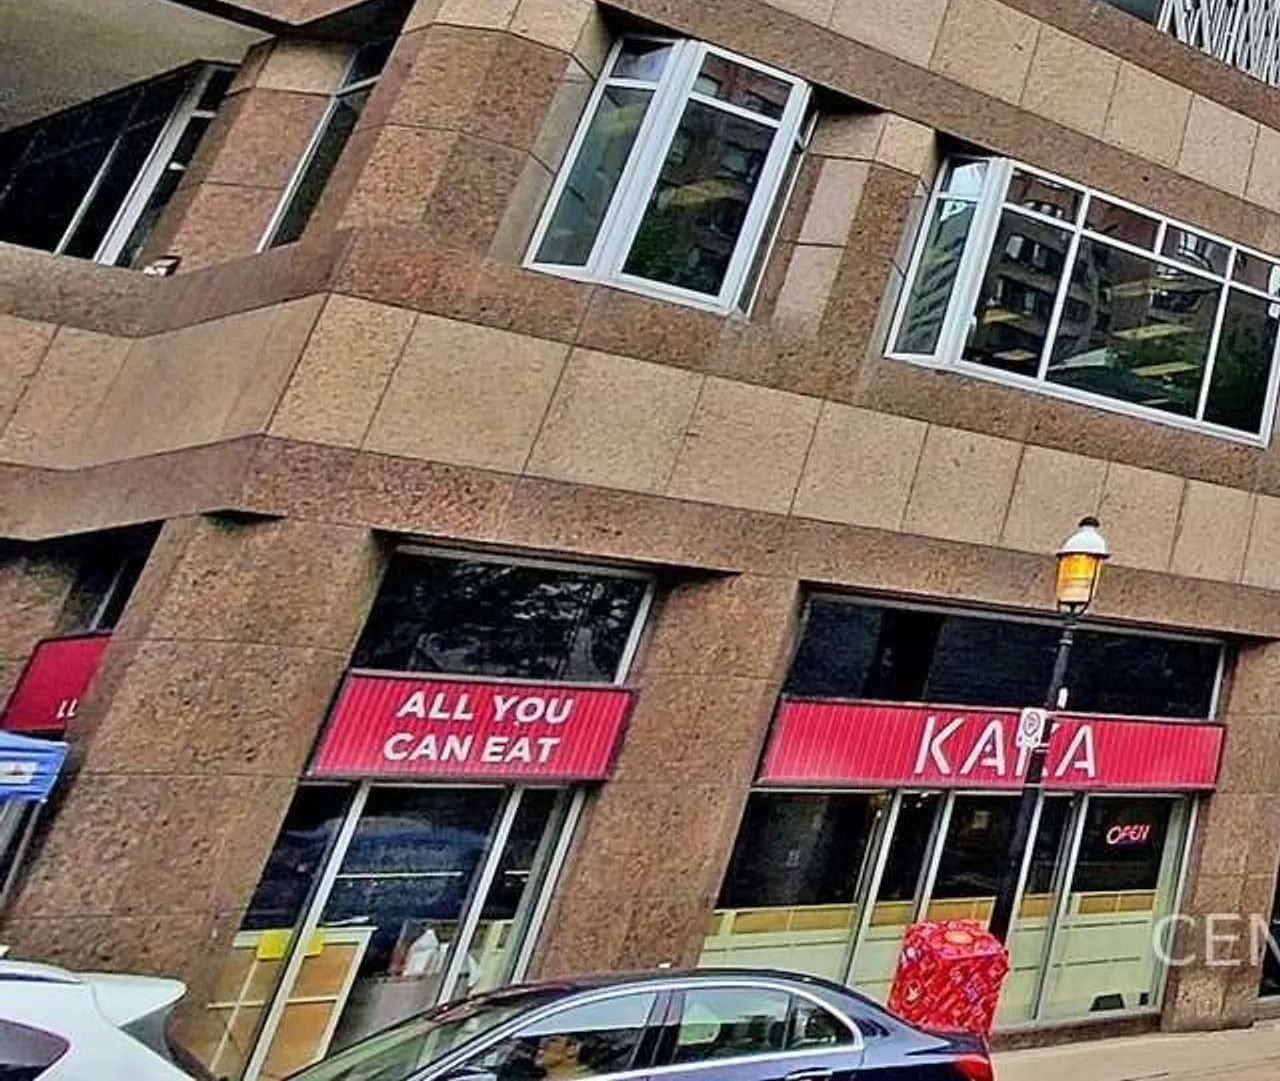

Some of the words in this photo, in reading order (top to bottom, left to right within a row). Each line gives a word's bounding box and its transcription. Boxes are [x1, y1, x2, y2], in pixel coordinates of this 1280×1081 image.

[396, 690, 473, 720] ALL
[493, 695, 574, 725] YOU
[382, 732, 473, 762] CAN
[480, 737, 560, 763] EAT
